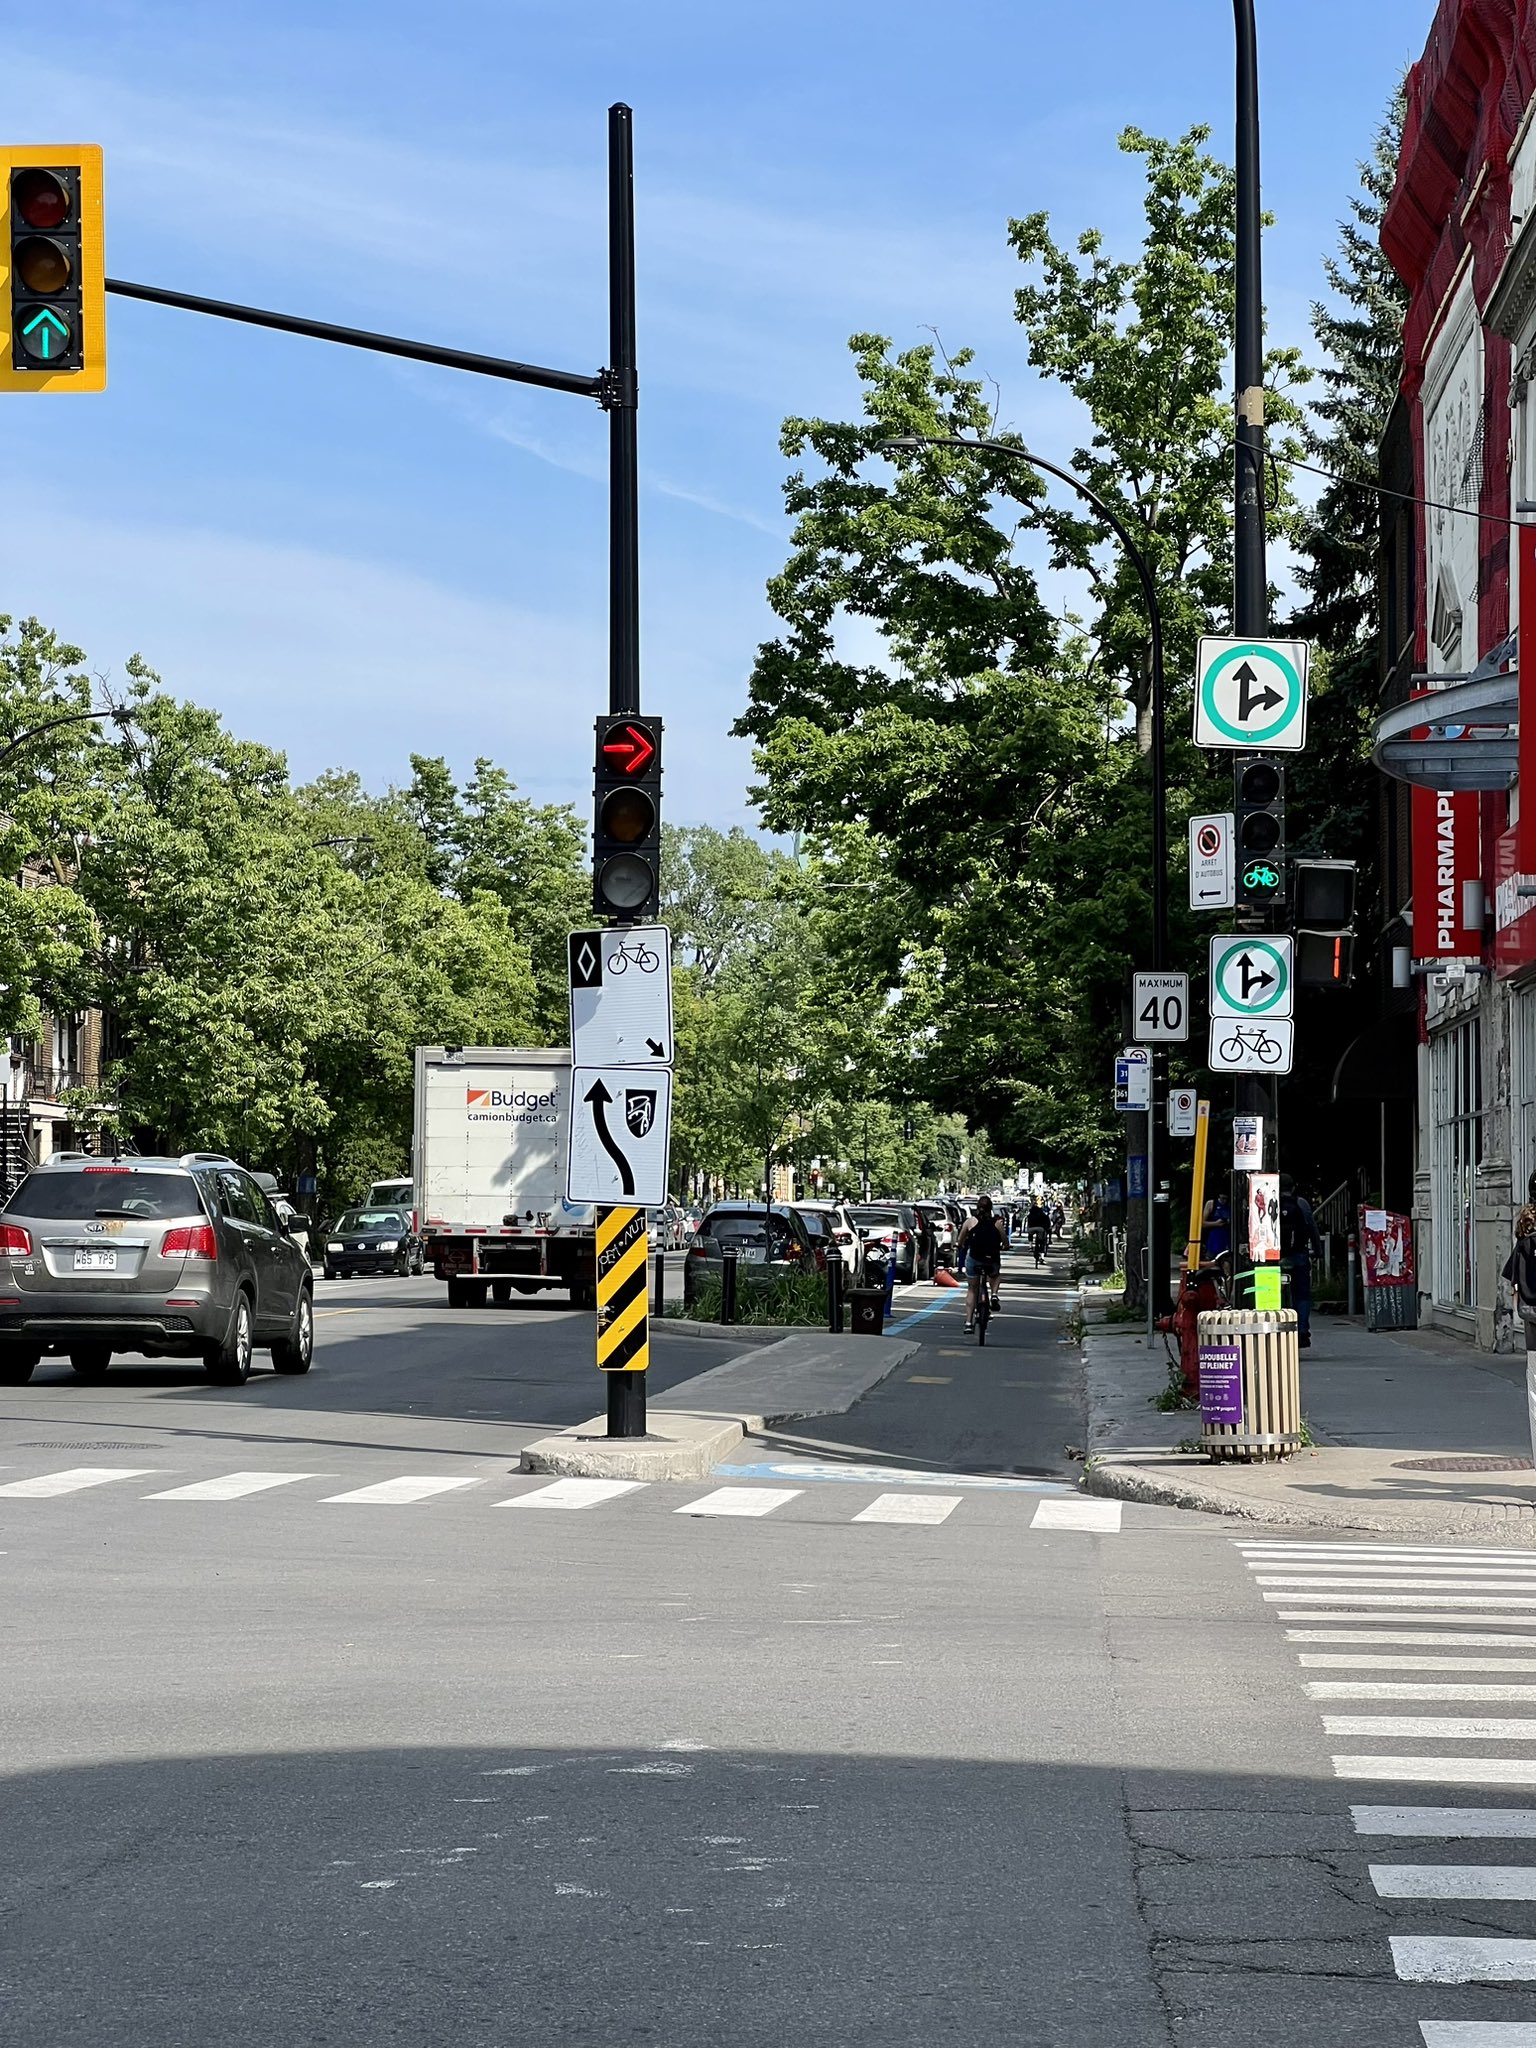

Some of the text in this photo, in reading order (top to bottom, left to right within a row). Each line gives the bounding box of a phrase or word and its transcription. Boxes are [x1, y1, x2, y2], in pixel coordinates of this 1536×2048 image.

[1437, 790, 1454, 949] PHARMAP
[1139, 979, 1183, 988] MAXIMUM
[1139, 996, 1183, 1030] 40
[1120, 1069, 1128, 1077] 31
[491, 1090, 556, 1111] Budget
[467, 1112, 557, 1124] camionbudget.ca
[98, 1253, 115, 1265] YPS
